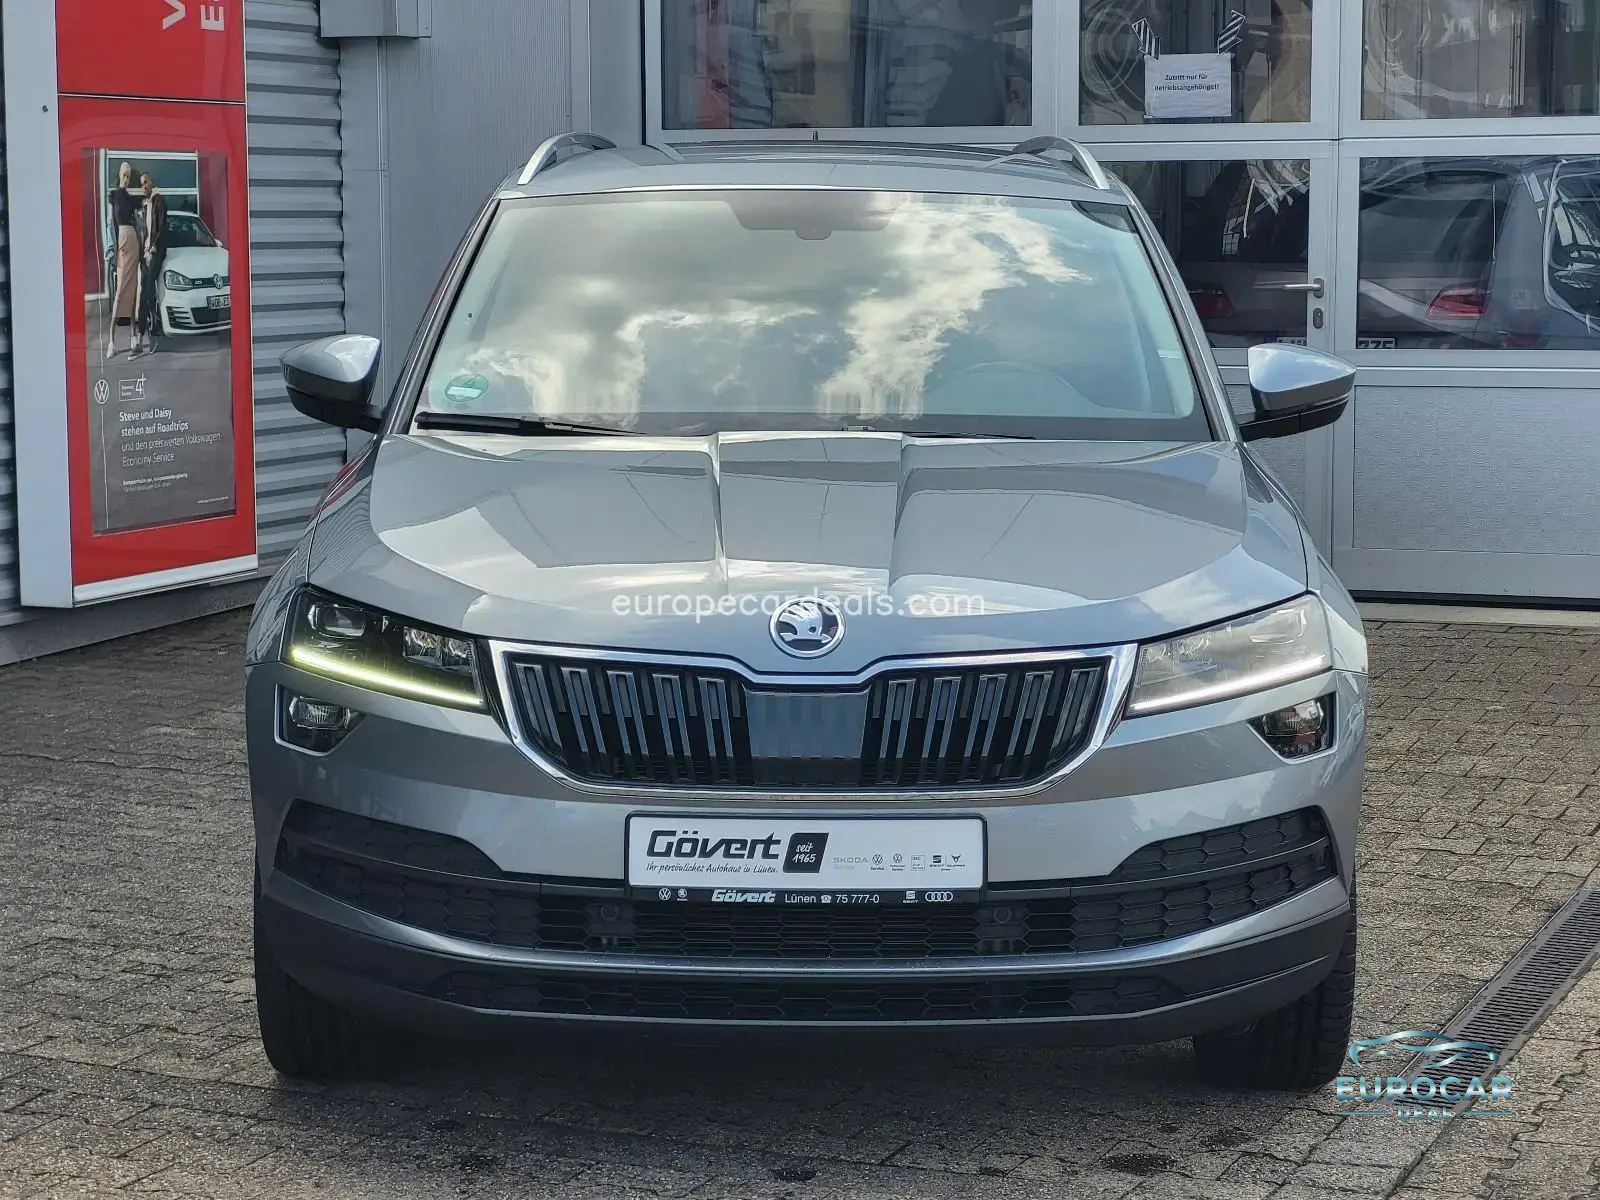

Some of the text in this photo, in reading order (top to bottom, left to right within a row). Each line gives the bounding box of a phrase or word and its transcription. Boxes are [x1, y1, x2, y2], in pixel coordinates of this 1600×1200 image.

[200, 0, 225, 31] E
[119, 407, 172, 422] Steve und Daisy
[121, 420, 189, 437] stehen auf Roadtrips
[121, 432, 221, 452] und den preiswerten Volkswagen
[122, 452, 176, 467] Economy Service
[647, 829, 782, 859] Gövert
[796, 841, 814, 853] seit
[792, 853, 817, 864] 1965
[646, 862, 657, 871] Ihr
[659, 861, 704, 874] persönliches
[706, 862, 741, 873] Autohaus
[743, 863, 751, 873] in
[711, 888, 776, 903] Gövert
[785, 893, 880, 904] Lünen 75 777-0
